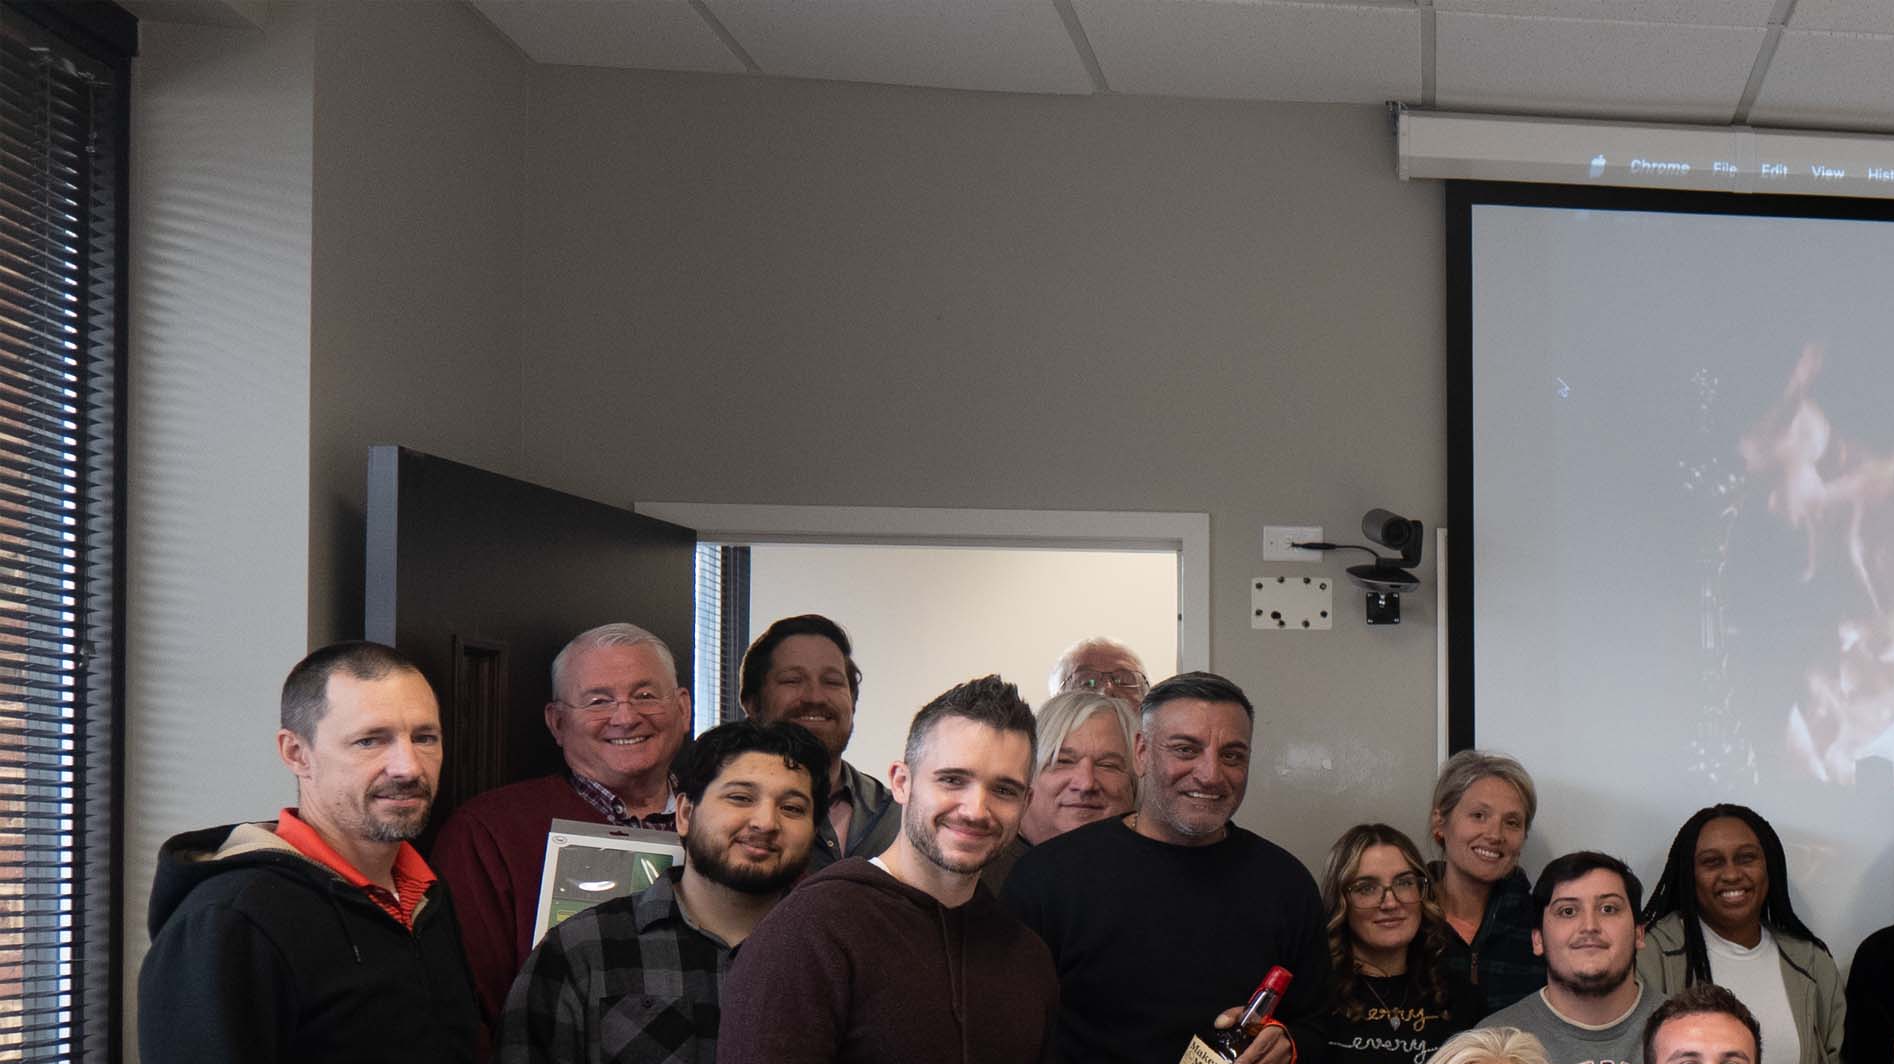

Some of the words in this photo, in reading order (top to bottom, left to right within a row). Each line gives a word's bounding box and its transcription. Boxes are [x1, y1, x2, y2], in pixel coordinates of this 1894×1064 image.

[1631, 159, 1691, 175] Chrome
[1712, 161, 1738, 176] File
[1761, 163, 1788, 179] Edit
[1811, 165, 1845, 180] View
